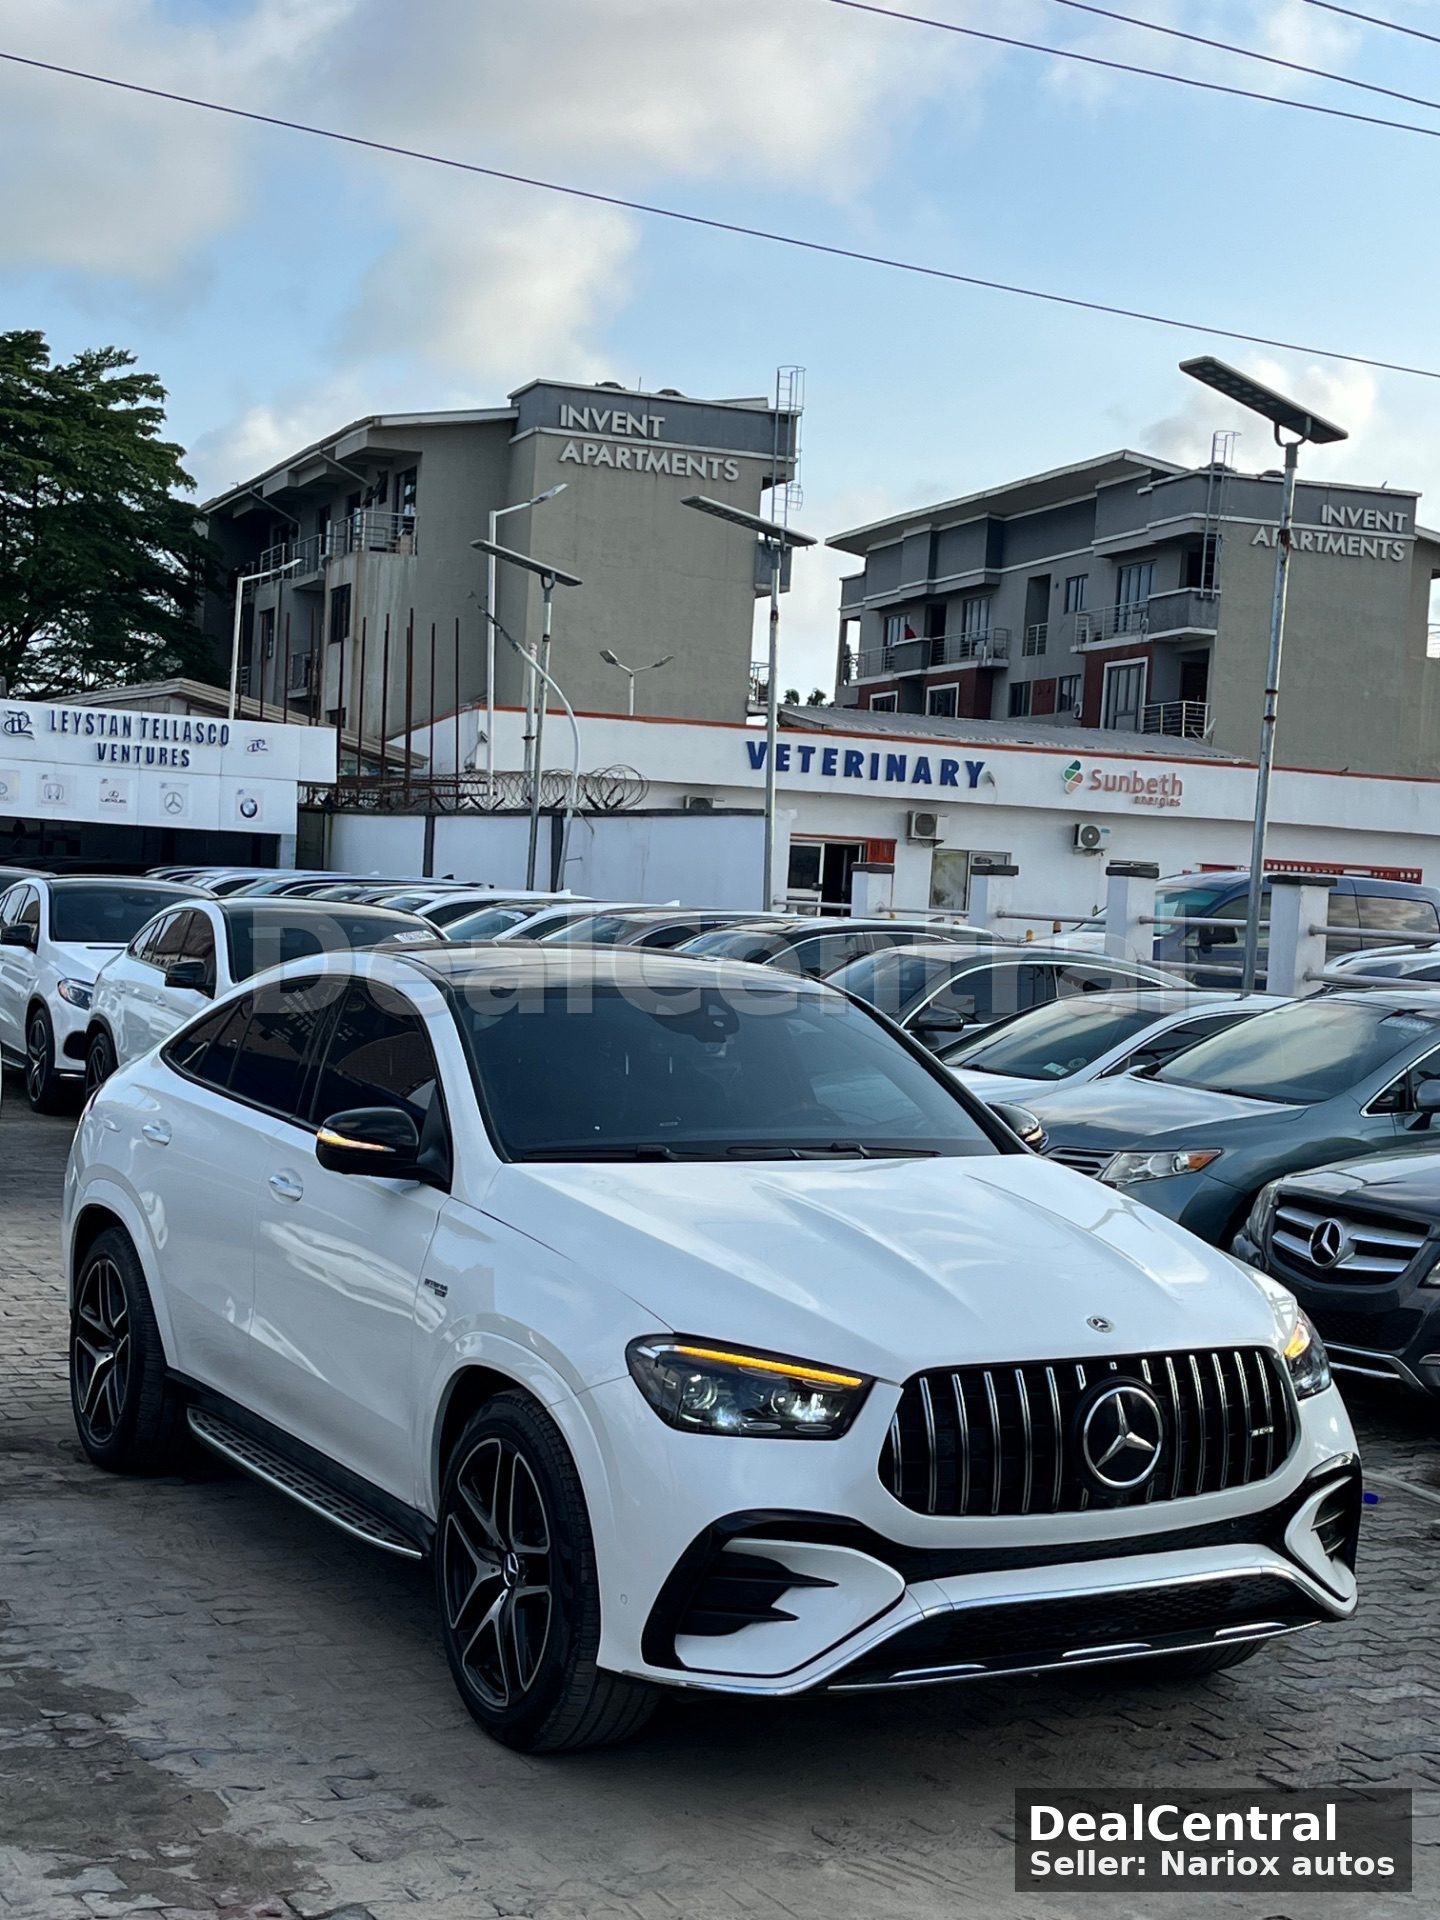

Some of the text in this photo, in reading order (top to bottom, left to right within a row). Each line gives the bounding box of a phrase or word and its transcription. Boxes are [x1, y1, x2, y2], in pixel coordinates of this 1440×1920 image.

[559, 404, 665, 438] INVENT
[559, 440, 740, 481] APARTMENTS
[1321, 504, 1408, 532] INVENT
[50, 709, 231, 746] LEYSTAN TELLASCO
[97, 742, 191, 768] VENTURES
[746, 740, 986, 789] VETERINARY
[1088, 768, 1183, 796] Sunbeth
[1134, 795, 1181, 809] energies
